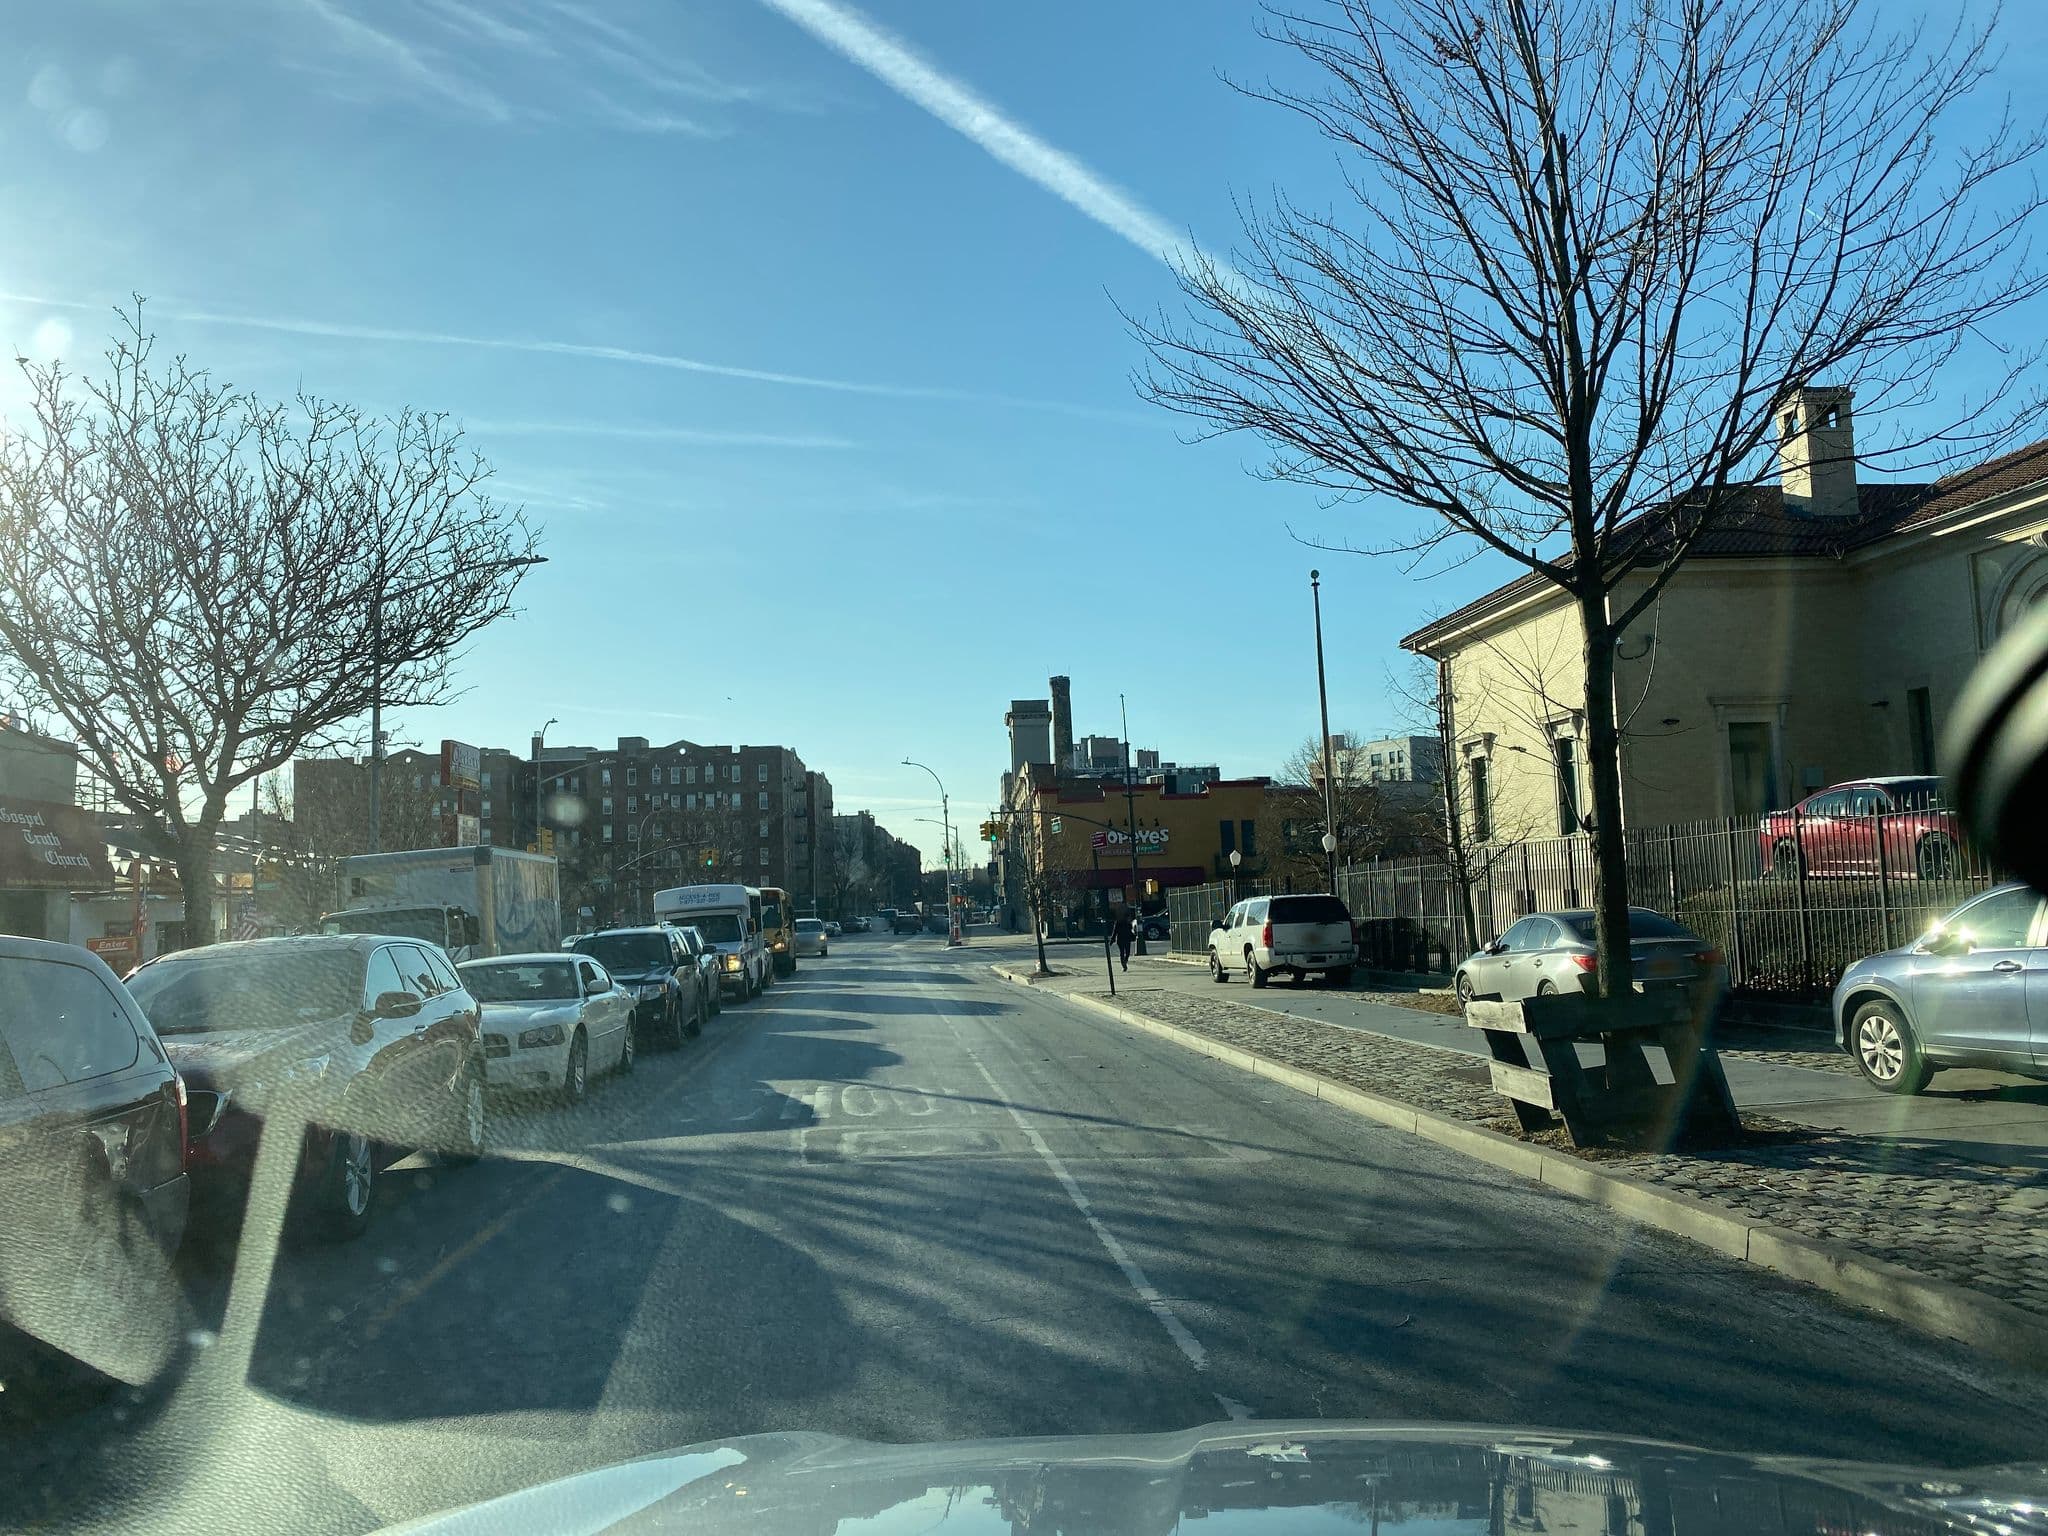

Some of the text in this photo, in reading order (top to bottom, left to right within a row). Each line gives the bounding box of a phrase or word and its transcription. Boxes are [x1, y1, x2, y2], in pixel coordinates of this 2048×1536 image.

[0, 808, 46, 827] Gospel
[22, 829, 62, 849] Truth
[44, 850, 92, 869] Church
[98, 941, 129, 949] Enter
